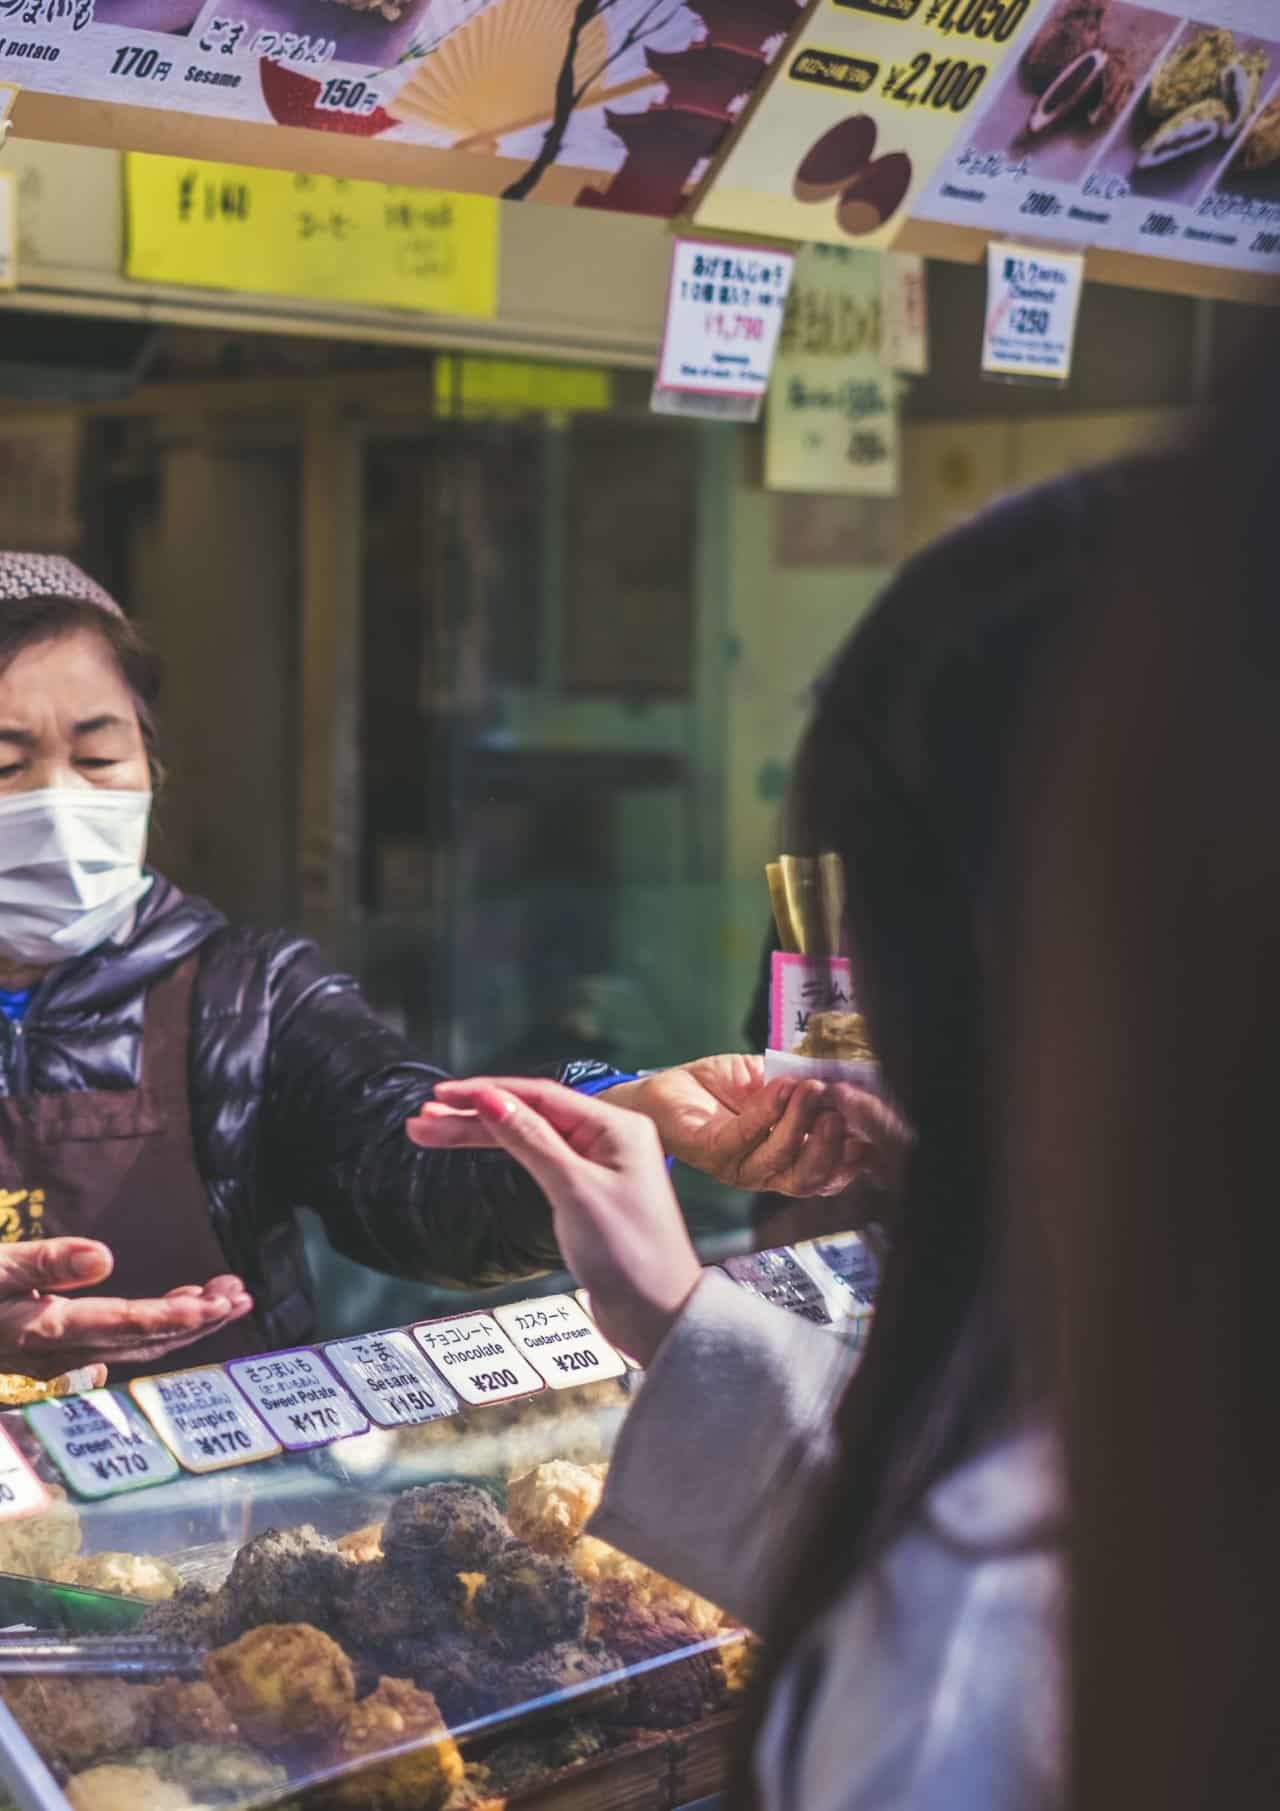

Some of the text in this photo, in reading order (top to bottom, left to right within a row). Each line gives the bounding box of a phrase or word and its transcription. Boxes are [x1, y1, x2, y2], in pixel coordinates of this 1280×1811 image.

[198, 19, 244, 54] ごま
[5, 40, 60, 62] potato
[109, 45, 173, 81] 170円
[183, 64, 242, 88] Sesame
[881, 52, 987, 112] ¥2,100
[514, 1306, 571, 1331] カスタード
[423, 1321, 494, 1349] チョコレート
[522, 1326, 593, 1349] Custard cream
[351, 1341, 395, 1364] ごま
[442, 1342, 506, 1366] chocolate
[551, 1348, 600, 1373] ¥200
[244, 1358, 313, 1384] さつまいも
[468, 1368, 520, 1394] ¥200
[260, 1385, 337, 1411] Sweet Potato
[65, 1438, 114, 1458] Green
[194, 1429, 252, 1456] ¥170
[89, 1453, 149, 1480] ¥170
